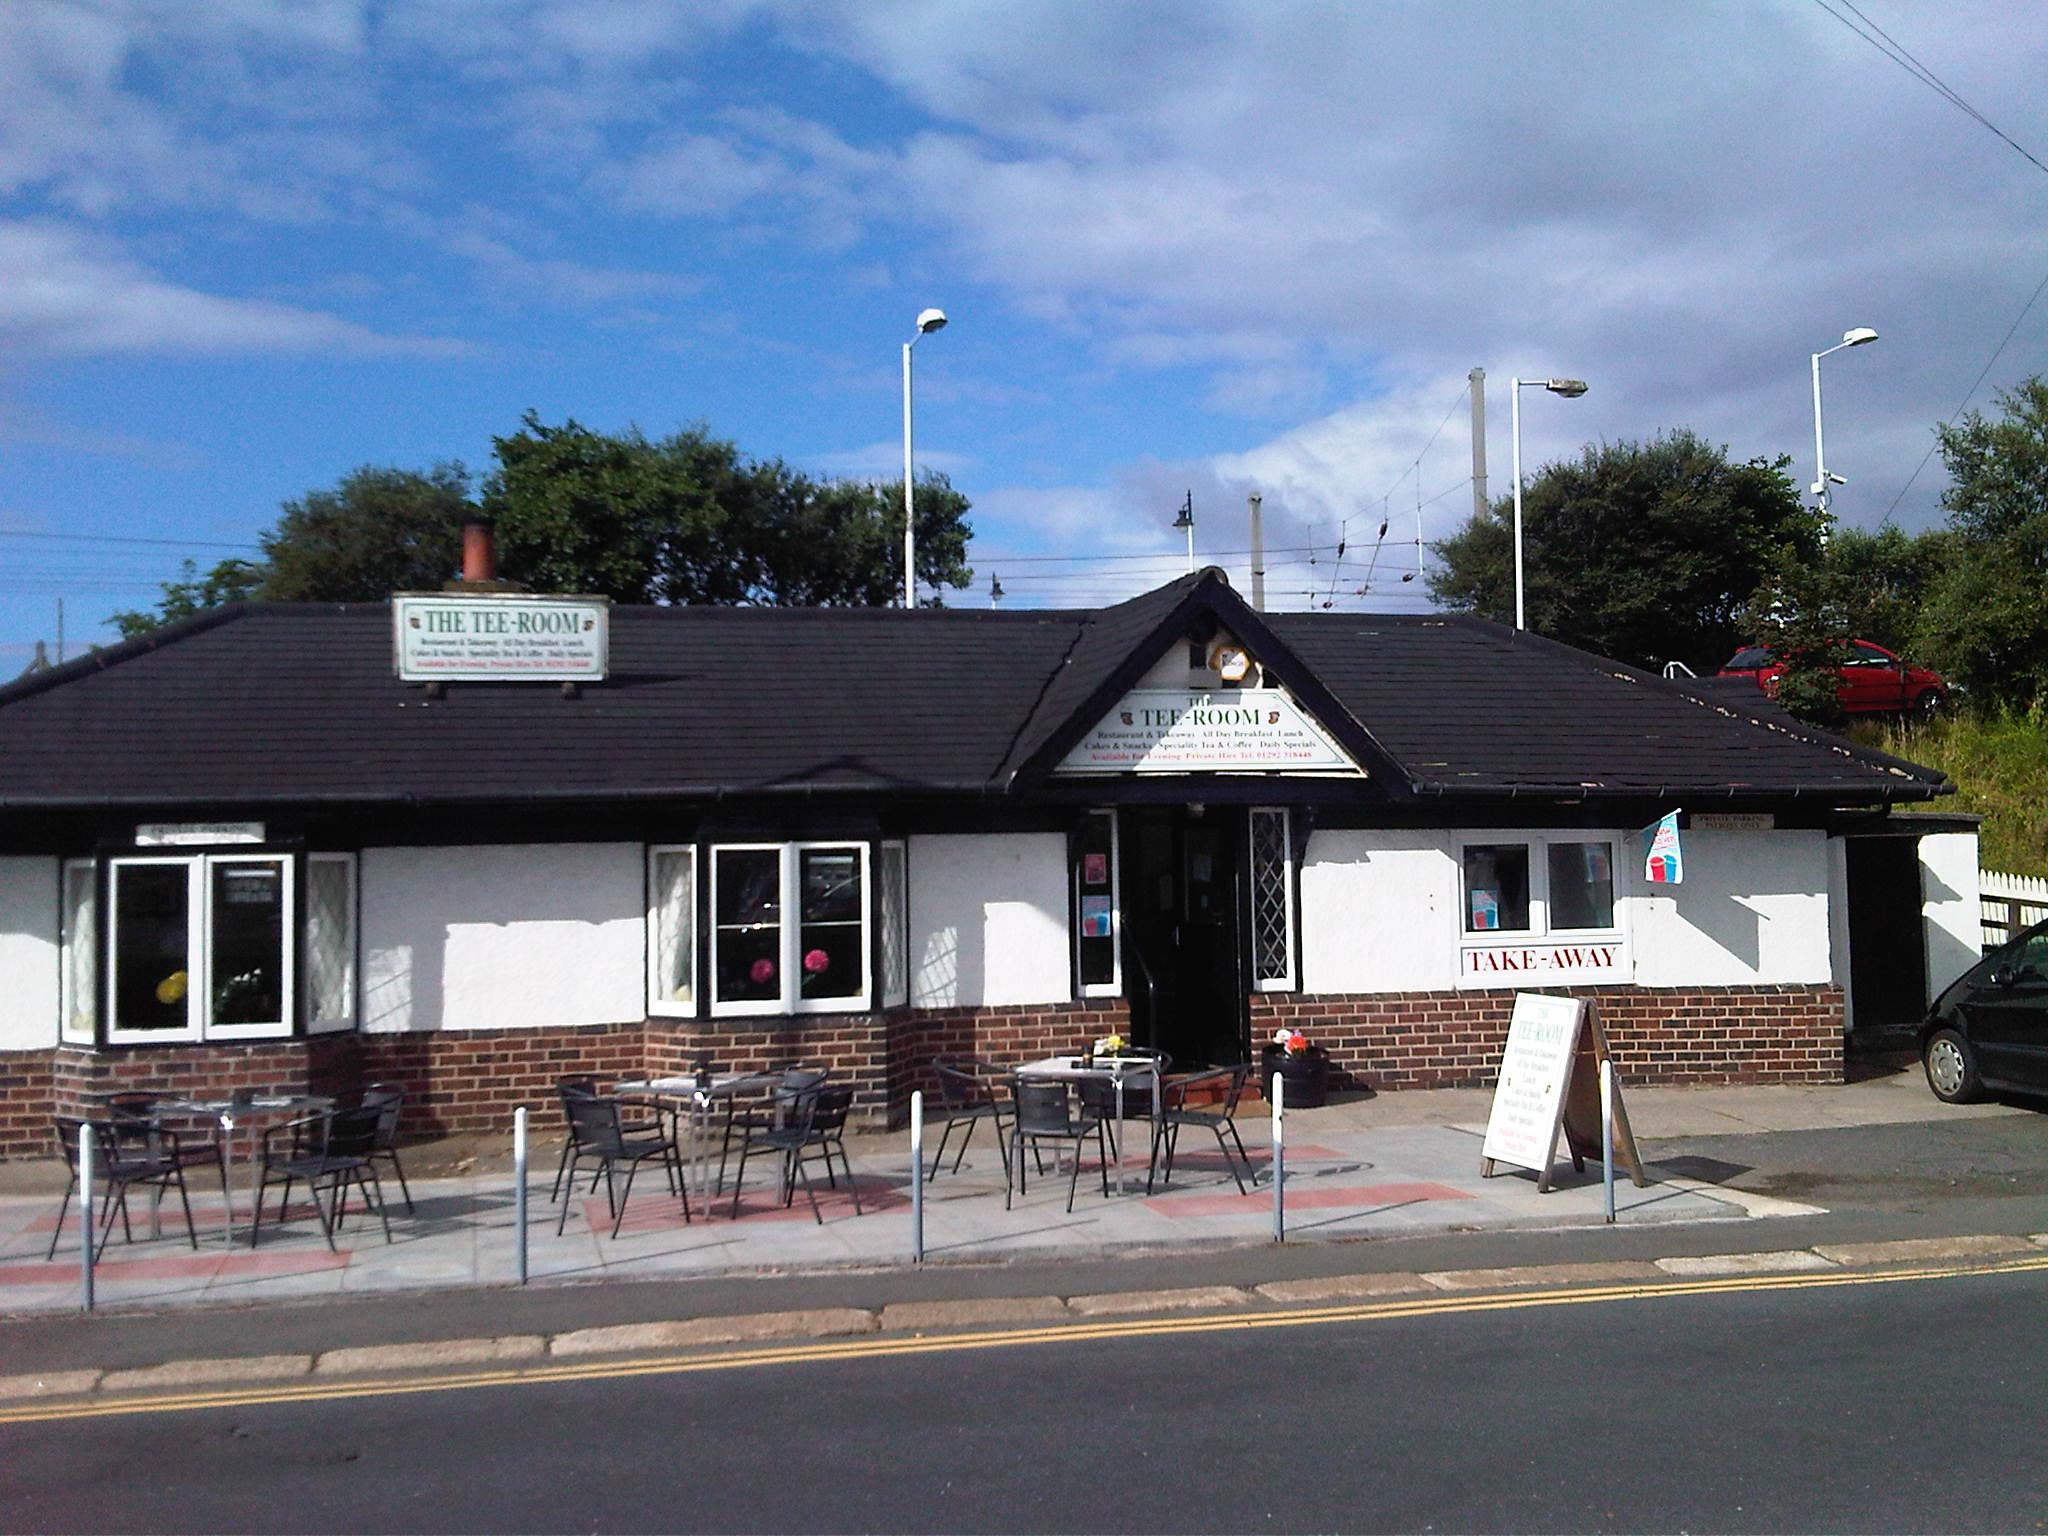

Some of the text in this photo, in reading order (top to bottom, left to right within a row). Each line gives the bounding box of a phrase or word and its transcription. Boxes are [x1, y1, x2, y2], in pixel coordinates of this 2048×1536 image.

[424, 610, 580, 635] THE TEE-ROOM
[1140, 708, 1259, 726] TEE-ROOM
[1098, 731, 1144, 739] Restaurant
[1146, 731, 1154, 739] &
[1216, 731, 1232, 739] Day
[1235, 730, 1273, 738] Breakfast
[1085, 742, 1111, 750] Cakes
[1112, 742, 1120, 750] &
[1123, 742, 1153, 750] Snacks
[1202, 741, 1215, 749] Tea
[1217, 741, 1225, 749] &
[1227, 741, 1252, 749] Coffee
[1260, 741, 1281, 750] Daily
[1284, 741, 1317, 749] Specials
[1467, 947, 1616, 971] TAKE-AWAY
